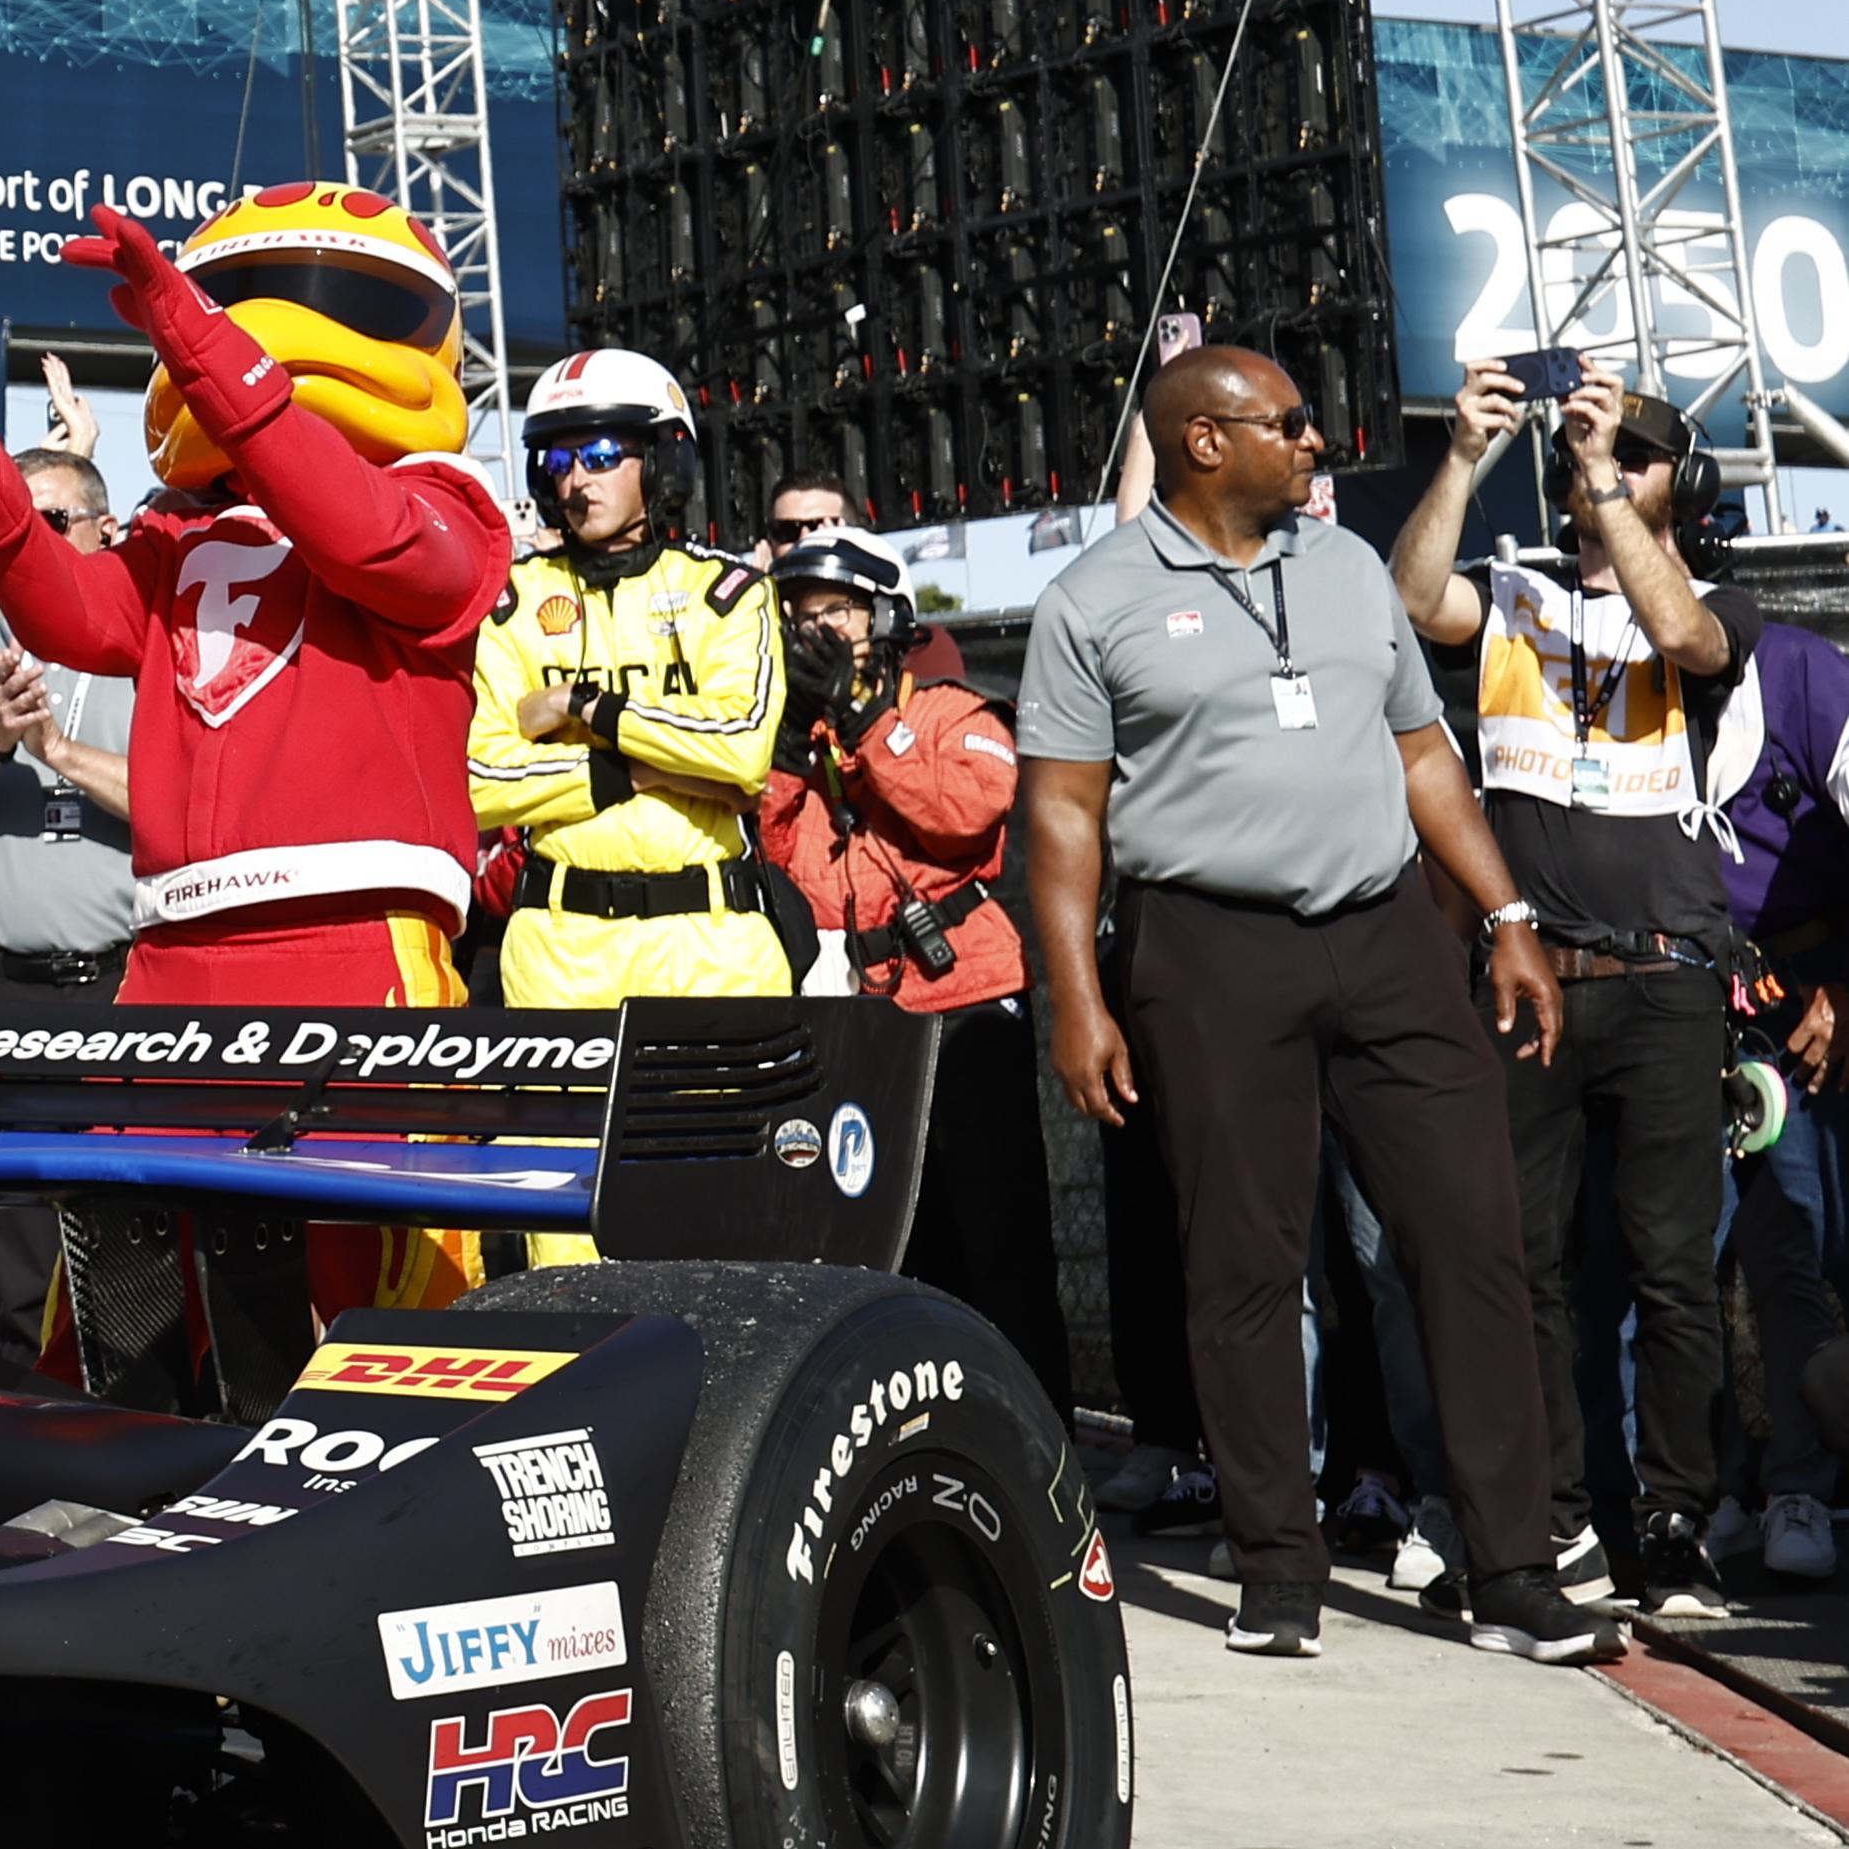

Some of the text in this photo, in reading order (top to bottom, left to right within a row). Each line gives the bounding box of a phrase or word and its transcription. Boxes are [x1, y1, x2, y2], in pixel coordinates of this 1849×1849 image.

[48, 168, 92, 220] of
[102, 172, 226, 221] LONG
[194, 235, 368, 262] FIREHAWK
[164, 866, 291, 908] FIREHAWK
[221, 1021, 270, 1064] &
[326, 1352, 533, 1393] DHL
[479, 1442, 605, 1499] TRENCH
[786, 1359, 965, 1586] Firestone
[502, 1487, 613, 1543] SHORING
[850, 1473, 919, 1551] RACING
[547, 1625, 617, 1663] mixes
[424, 1687, 633, 1828] HRC
[425, 1795, 630, 1849] Honda RACING
